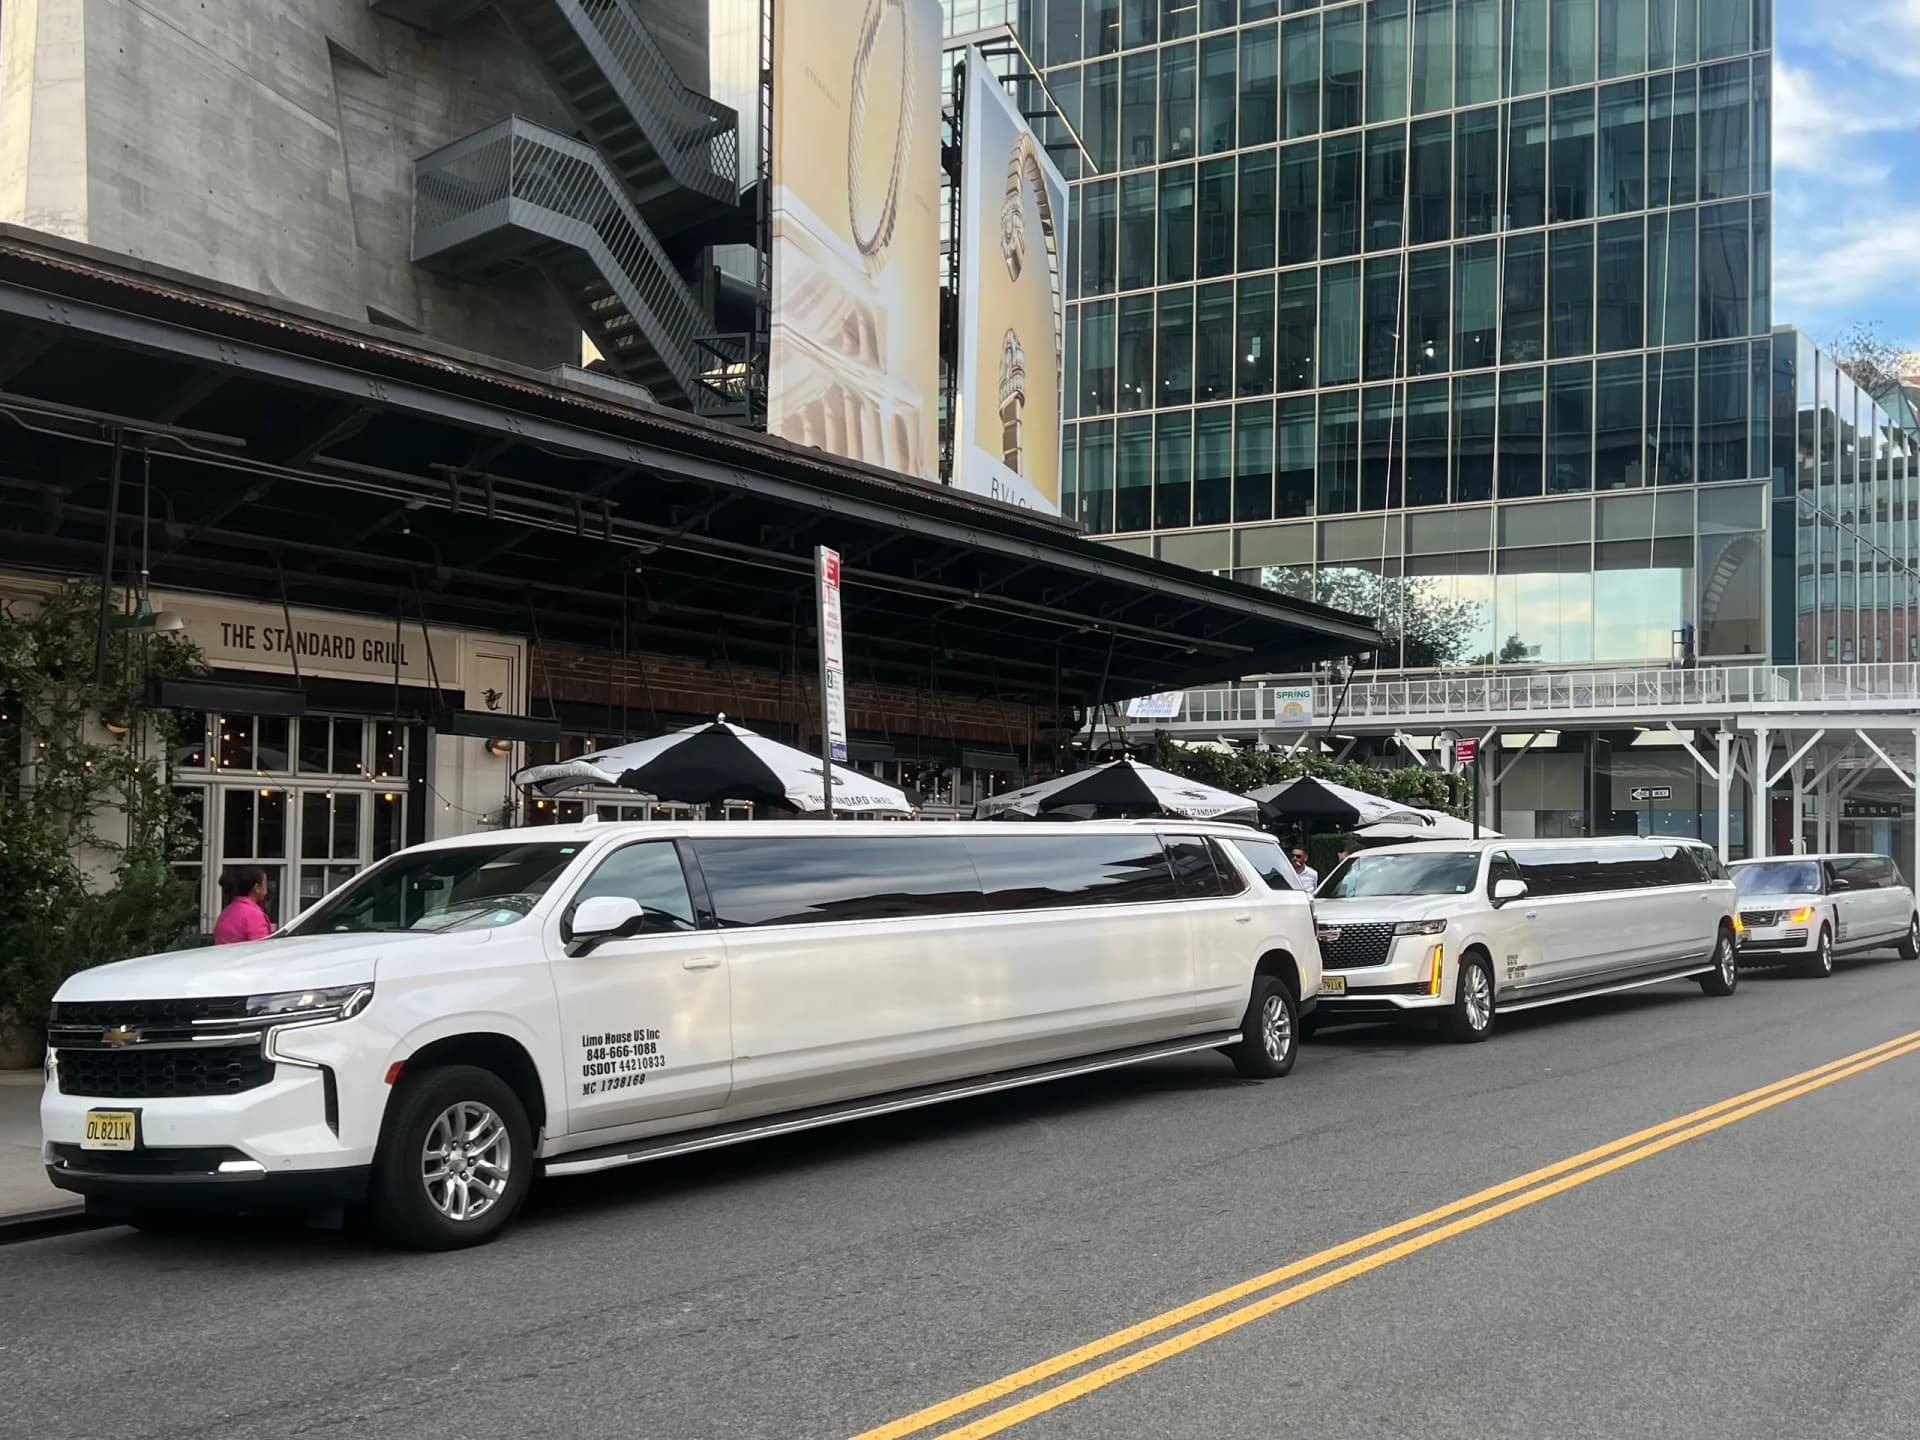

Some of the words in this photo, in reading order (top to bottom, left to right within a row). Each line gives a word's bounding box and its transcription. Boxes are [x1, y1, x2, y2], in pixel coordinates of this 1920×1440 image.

[221, 622, 255, 650] THE
[262, 627, 355, 660] STANDARD
[362, 639, 409, 666] GRILL
[1275, 689, 1311, 699] SPRING
[1176, 807, 1189, 816] THE
[1848, 806, 1899, 814] TESLA
[582, 1034, 604, 1047] Limo
[605, 1031, 632, 1045] House
[633, 1029, 645, 1042] US
[646, 1028, 660, 1041] Inc
[582, 1061, 617, 1077] USDOT
[619, 1055, 666, 1072] 44210833
[582, 1081, 597, 1096] MC
